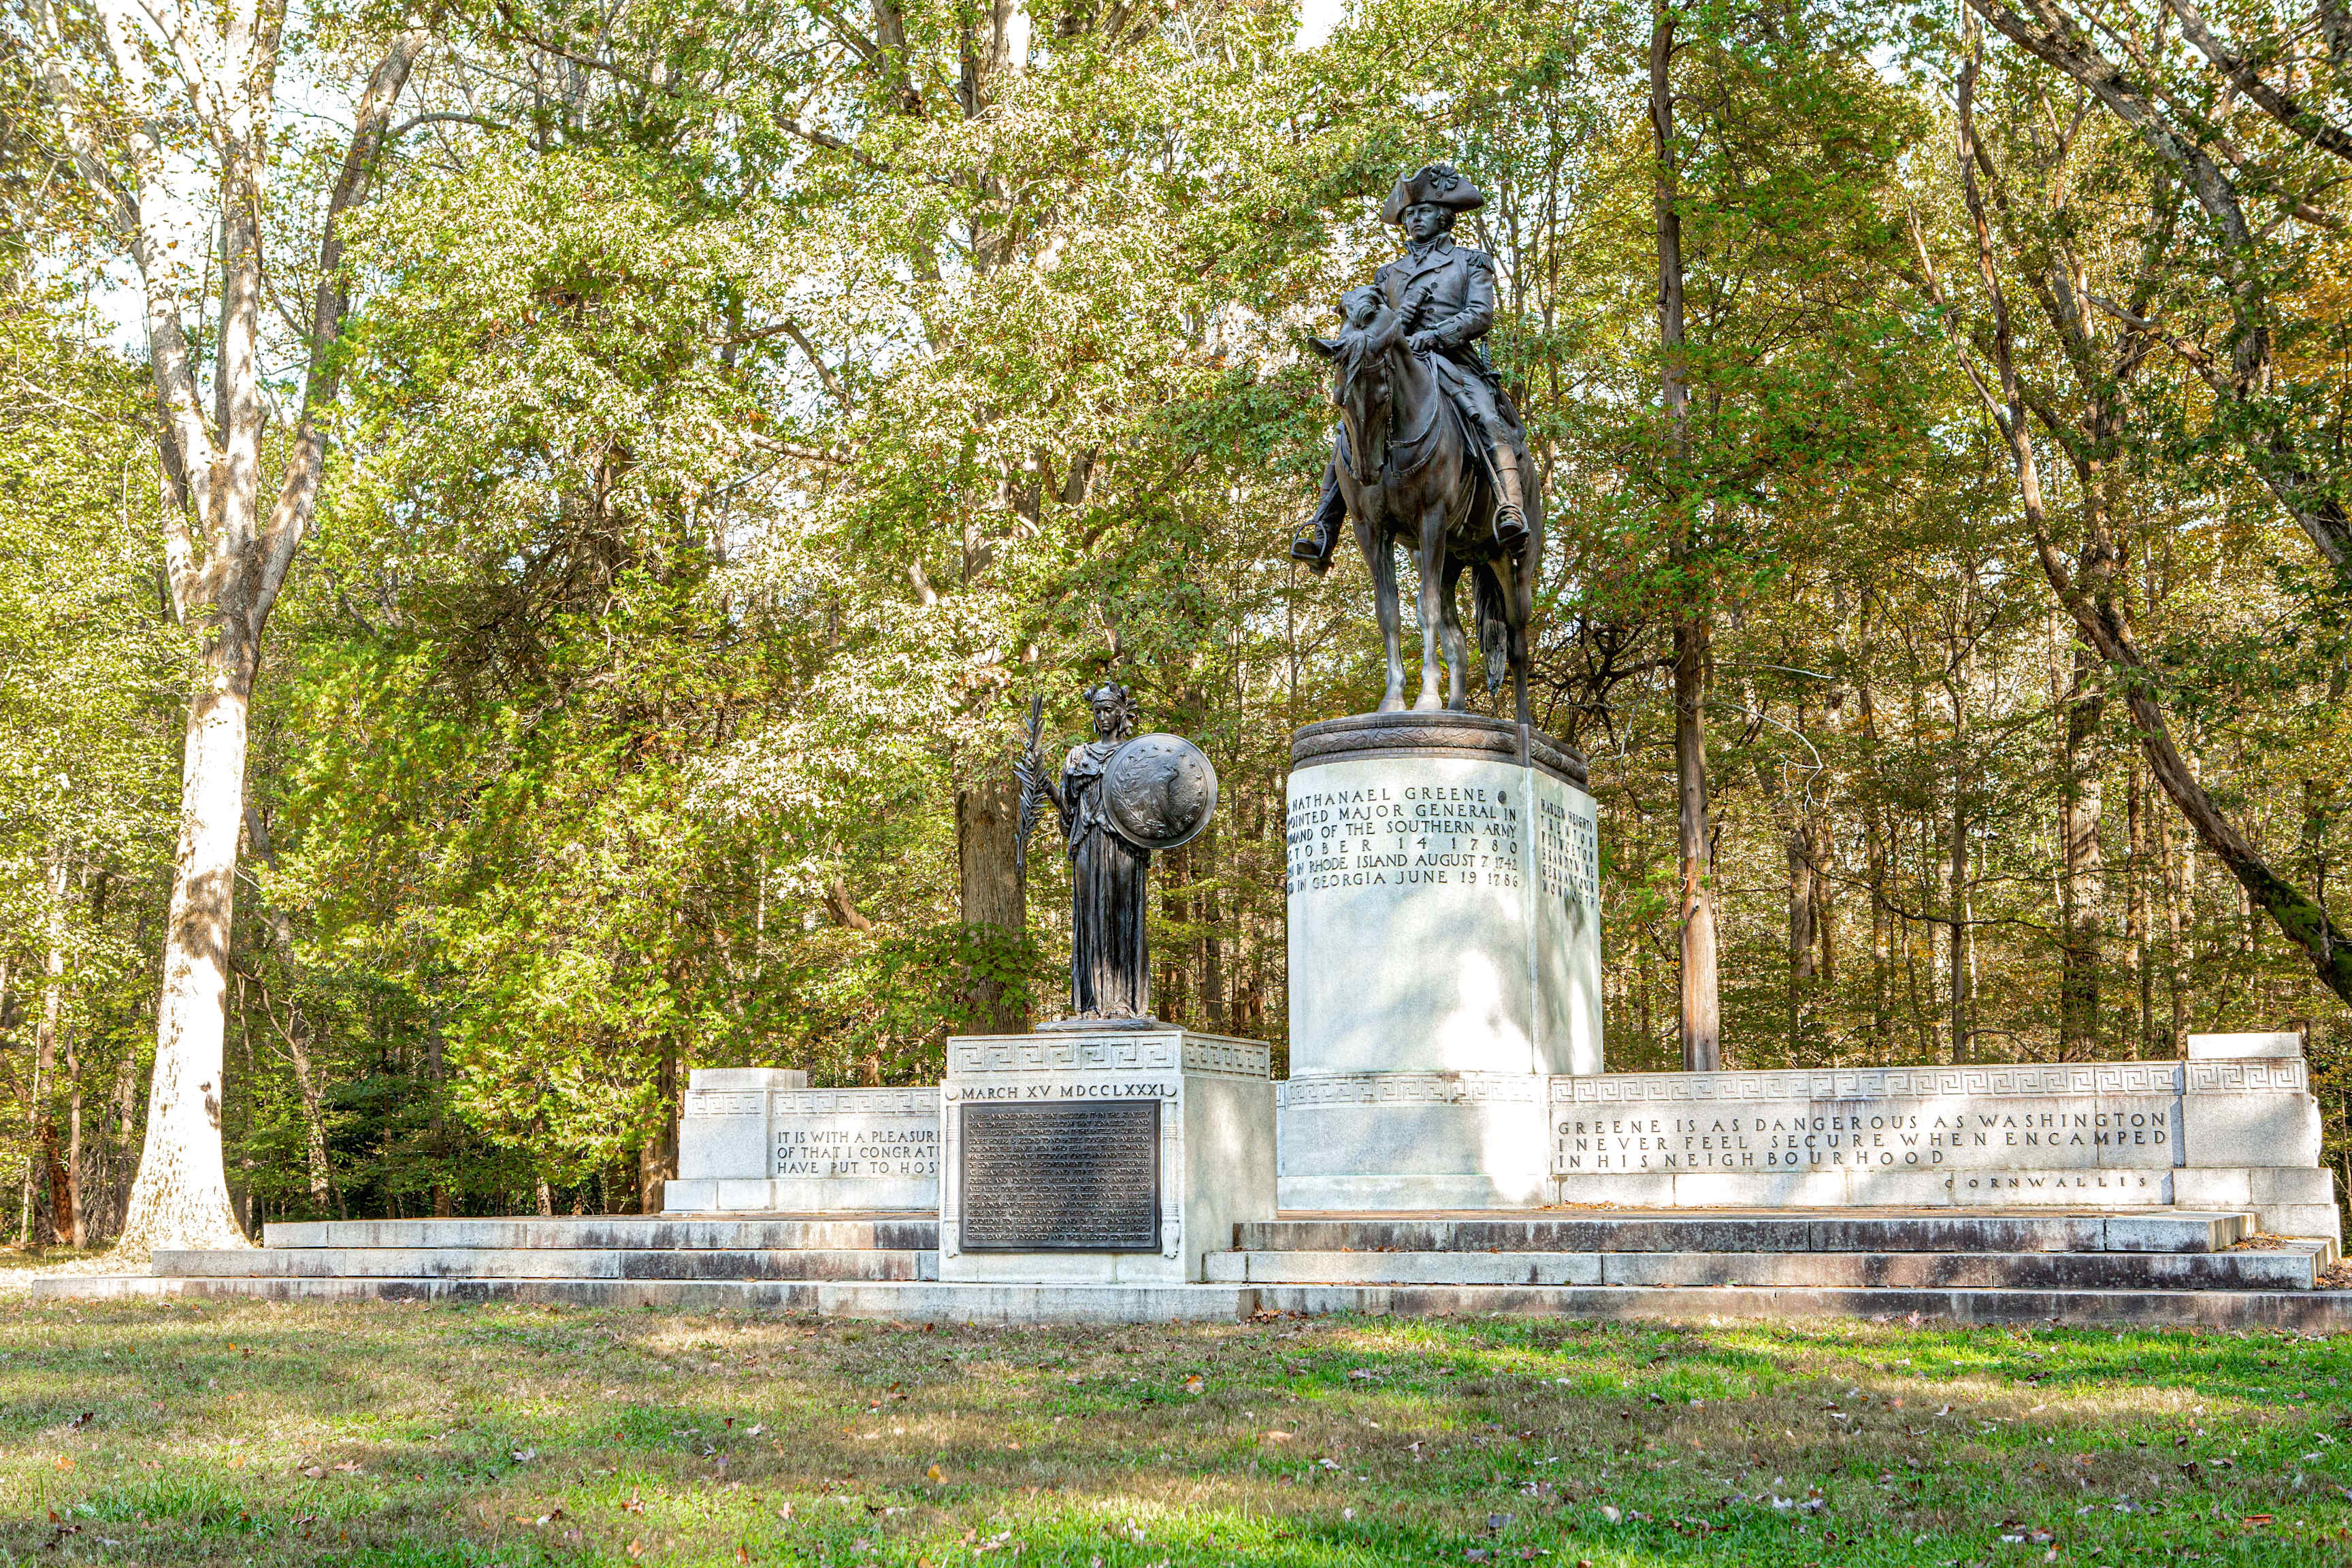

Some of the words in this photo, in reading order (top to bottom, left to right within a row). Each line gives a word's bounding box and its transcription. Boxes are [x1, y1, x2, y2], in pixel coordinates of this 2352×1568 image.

[1292, 788, 1390, 811] NATHANAEL
[1405, 787, 1486, 802] GREENE
[1339, 804, 1404, 820] MAJOR
[1415, 804, 1497, 819] GENERAL
[1504, 808, 1516, 821] IN
[1568, 811, 1592, 833] HEIGHTS
[1321, 825, 1338, 838] OF
[1345, 822, 1375, 836] THE
[1386, 820, 1474, 834] SOUTHERN
[1482, 823, 1516, 838] ARMY
[1541, 815, 1593, 848] TRENTON
[1399, 836, 1427, 849] 14
[1451, 836, 1518, 853] 1780
[1541, 830, 1593, 862] PRINCETON
[1296, 863, 1304, 875] IN
[1309, 857, 1348, 873] RHODE
[1357, 853, 1407, 868] ISLAND
[1415, 853, 1476, 867] AUGUST
[1481, 855, 1489, 867] 7
[1494, 856, 1518, 870] 1742
[1297, 878, 1307, 892] IN
[1312, 871, 1386, 889] GEORGIA
[1395, 870, 1448, 885] JUNE
[1460, 870, 1477, 883] 19
[1488, 872, 1518, 887] 1786
[962, 1087, 1018, 1099] MARCH
[1027, 1085, 1051, 1098] XV
[1060, 1083, 1165, 1097] MDCCLXXXI
[1558, 1120, 1661, 1134] GREENE
[1676, 1119, 1695, 1132] IS
[1712, 1118, 1739, 1132] AS
[1755, 1115, 1917, 1131] DANGEROUS
[1933, 1115, 1963, 1128] AS
[1978, 1112, 2165, 1128] WASHINGTON
[778, 1131, 789, 1143] IT
[795, 1131, 805, 1143] IS
[811, 1131, 849, 1143] WITH
[854, 1132, 866, 1143] A
[1558, 1139, 1563, 1152] I
[1576, 1137, 1667, 1152] NEVER
[1684, 1136, 1748, 1150] FEEL
[1771, 1133, 1884, 1148] SECURE
[1899, 1131, 1986, 1146] WHEN
[2005, 1130, 2166, 1145] ENCAMPED
[777, 1147, 796, 1159] OF
[801, 1146, 840, 1158] THAT
[847, 1146, 851, 1158] I
[1558, 1154, 1581, 1168] IN
[1598, 1154, 1648, 1168] HIS
[1665, 1149, 1944, 1167] NEIGHBOURHOOD
[777, 1162, 819, 1173] HAVE
[830, 1162, 859, 1173] PUT
[870, 1162, 889, 1173] TO
[900, 1162, 940, 1173] HOS
[1944, 1177, 2146, 1188] CORNWALLIS
